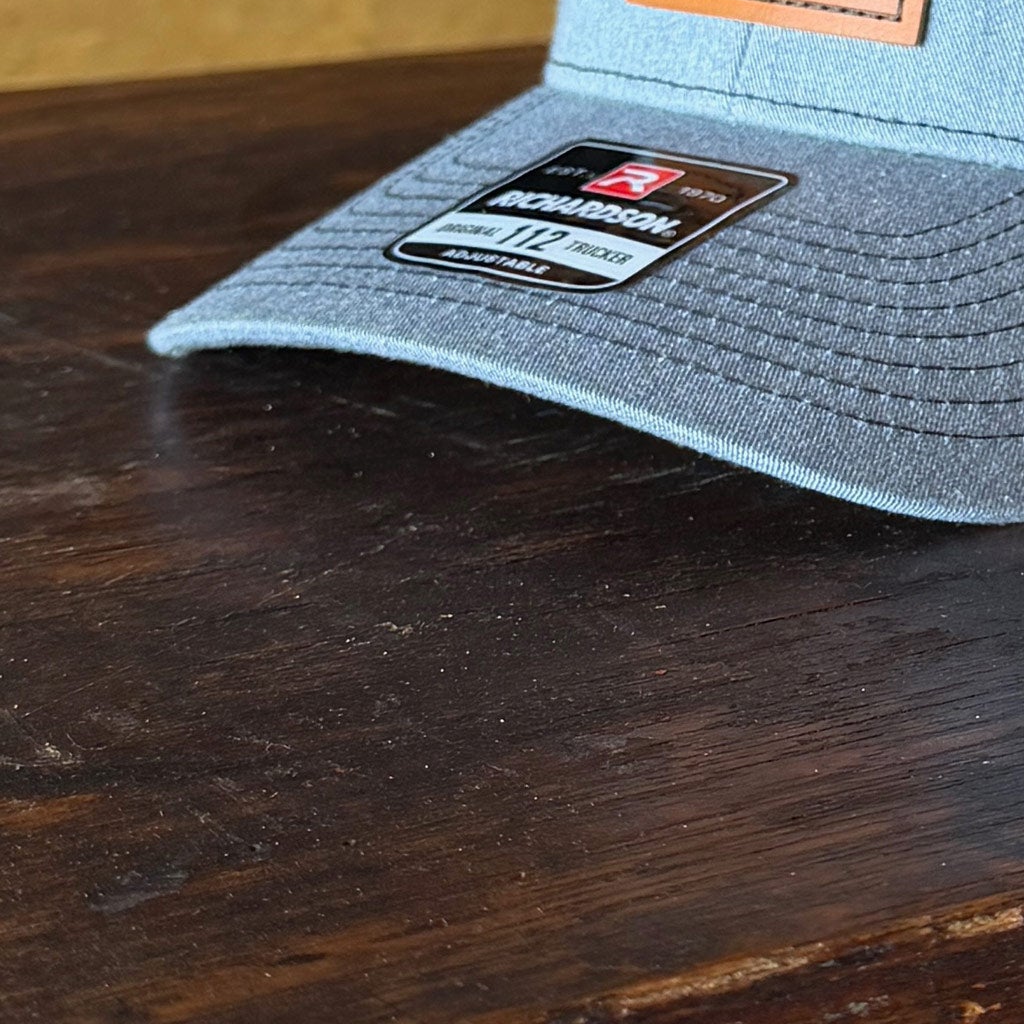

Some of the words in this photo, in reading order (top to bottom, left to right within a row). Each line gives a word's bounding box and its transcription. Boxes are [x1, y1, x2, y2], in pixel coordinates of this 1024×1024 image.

[440, 248, 550, 275] ADJUSTABLE
[496, 224, 570, 251] 112
[564, 240, 634, 266] TRUCKER
